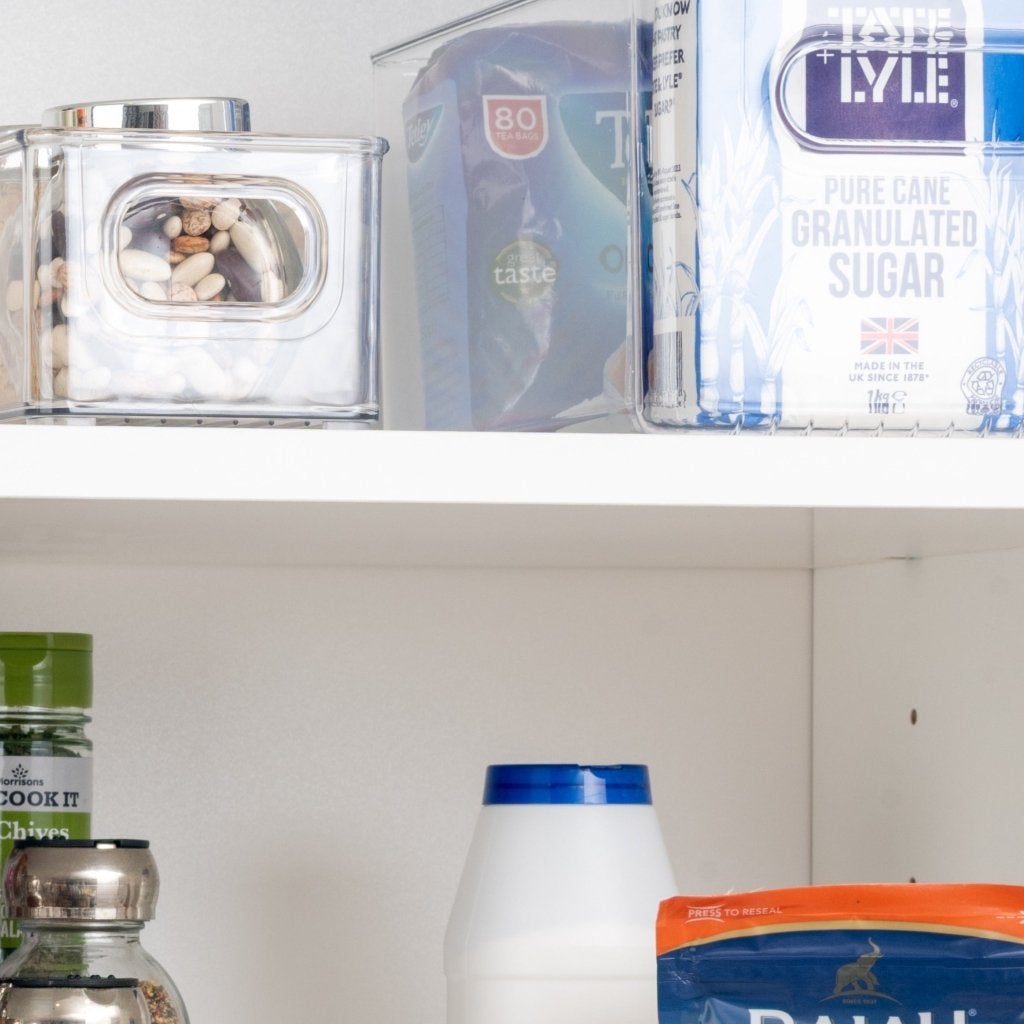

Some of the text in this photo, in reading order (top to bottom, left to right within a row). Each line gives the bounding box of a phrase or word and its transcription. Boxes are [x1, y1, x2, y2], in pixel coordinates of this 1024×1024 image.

[827, 7, 952, 54] TATE
[495, 107, 537, 131] 80
[495, 131, 540, 141] TEA BAGS
[825, 175, 951, 206] PURE CANE
[791, 209, 978, 247] GRANULATED
[492, 264, 557, 285] taste
[828, 252, 945, 299] SUGAR
[854, 361, 924, 371] MADE IN THE
[849, 373, 864, 382] UK
[867, 373, 899, 382] SINCE
[62, 791, 80, 808] IT
[688, 906, 783, 919] PRESS TO RESEAL
